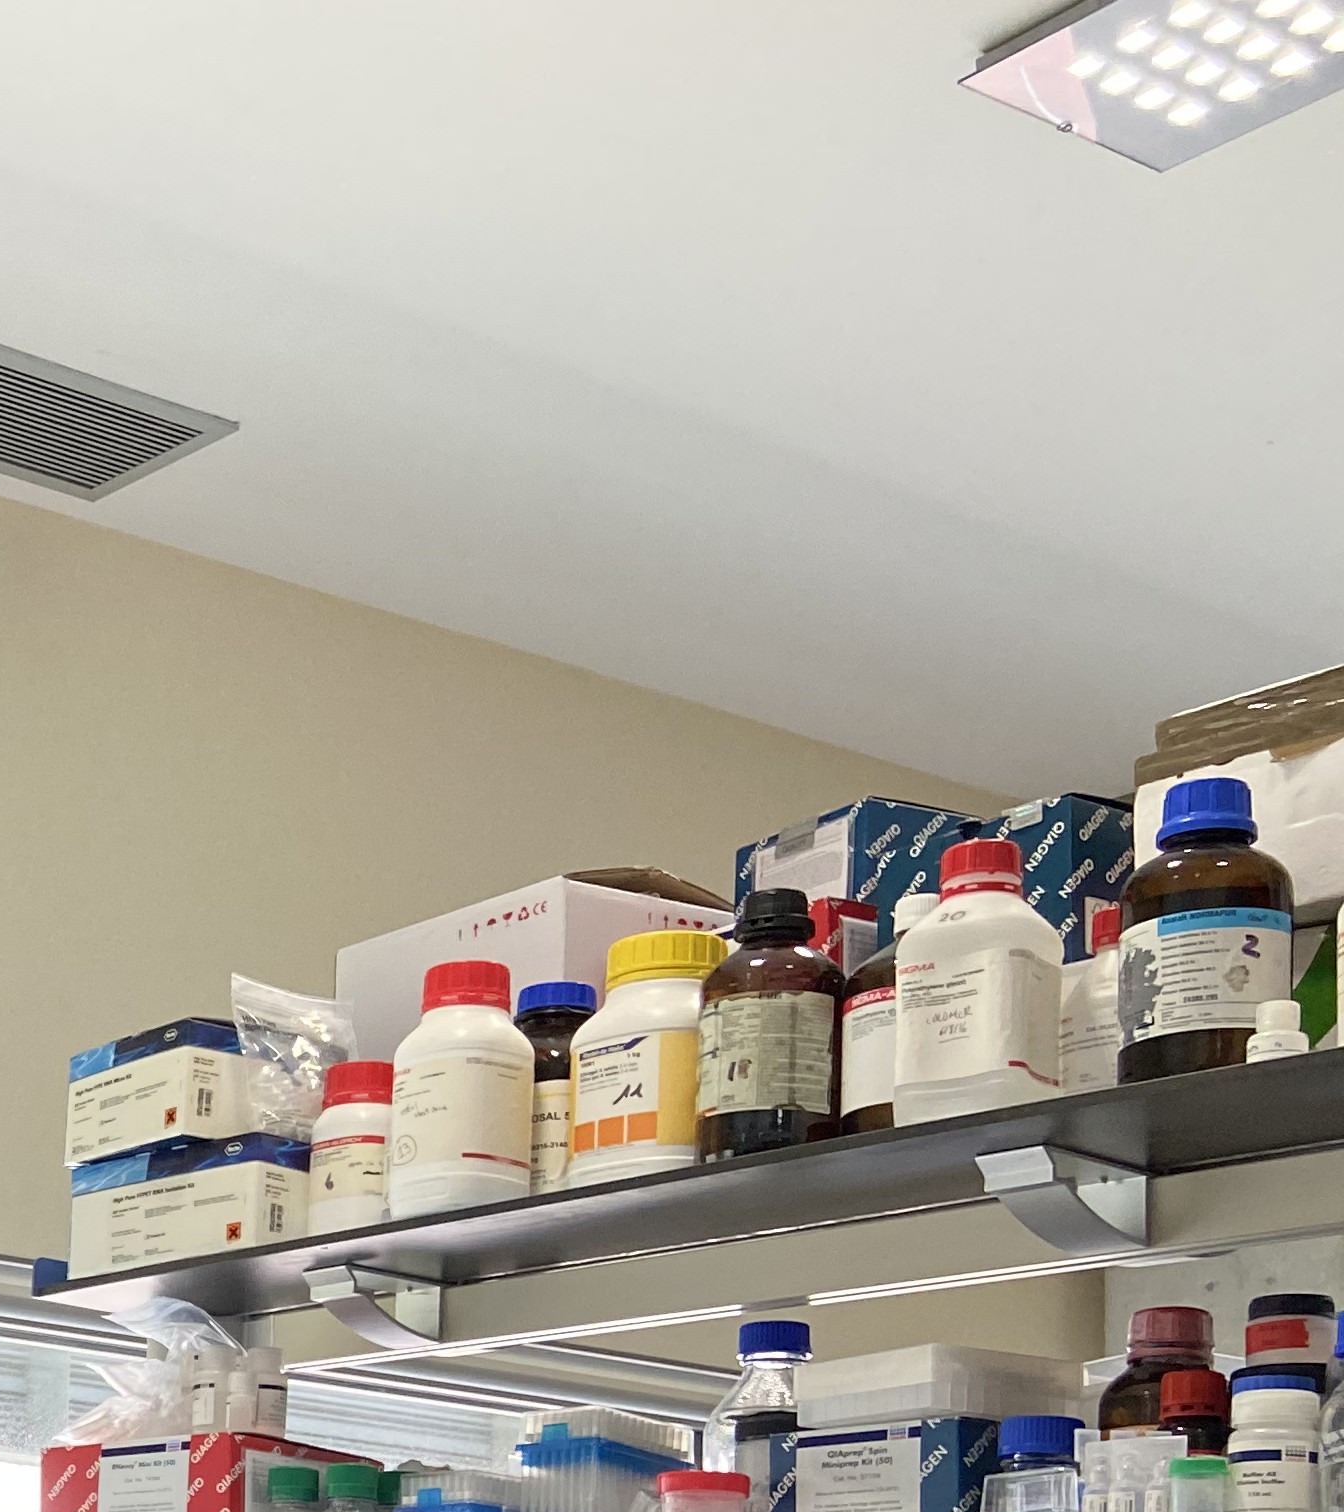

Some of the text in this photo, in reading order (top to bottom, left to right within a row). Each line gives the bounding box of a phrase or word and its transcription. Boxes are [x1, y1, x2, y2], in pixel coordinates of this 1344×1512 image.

[865, 823, 902, 859] QIAGEN
[1078, 805, 1110, 842] QIAGEN
[1024, 821, 1065, 872] QIAGEN
[1058, 858, 1095, 899] QIAGEN
[938, 910, 967, 923] 20
[1241, 933, 1261, 959] 2
[821, 1456, 893, 1470] Miniprep Kit (50)
[827, 1446, 888, 1460] QIAprep Spin
[47, 1463, 77, 1501] QIAGEN
